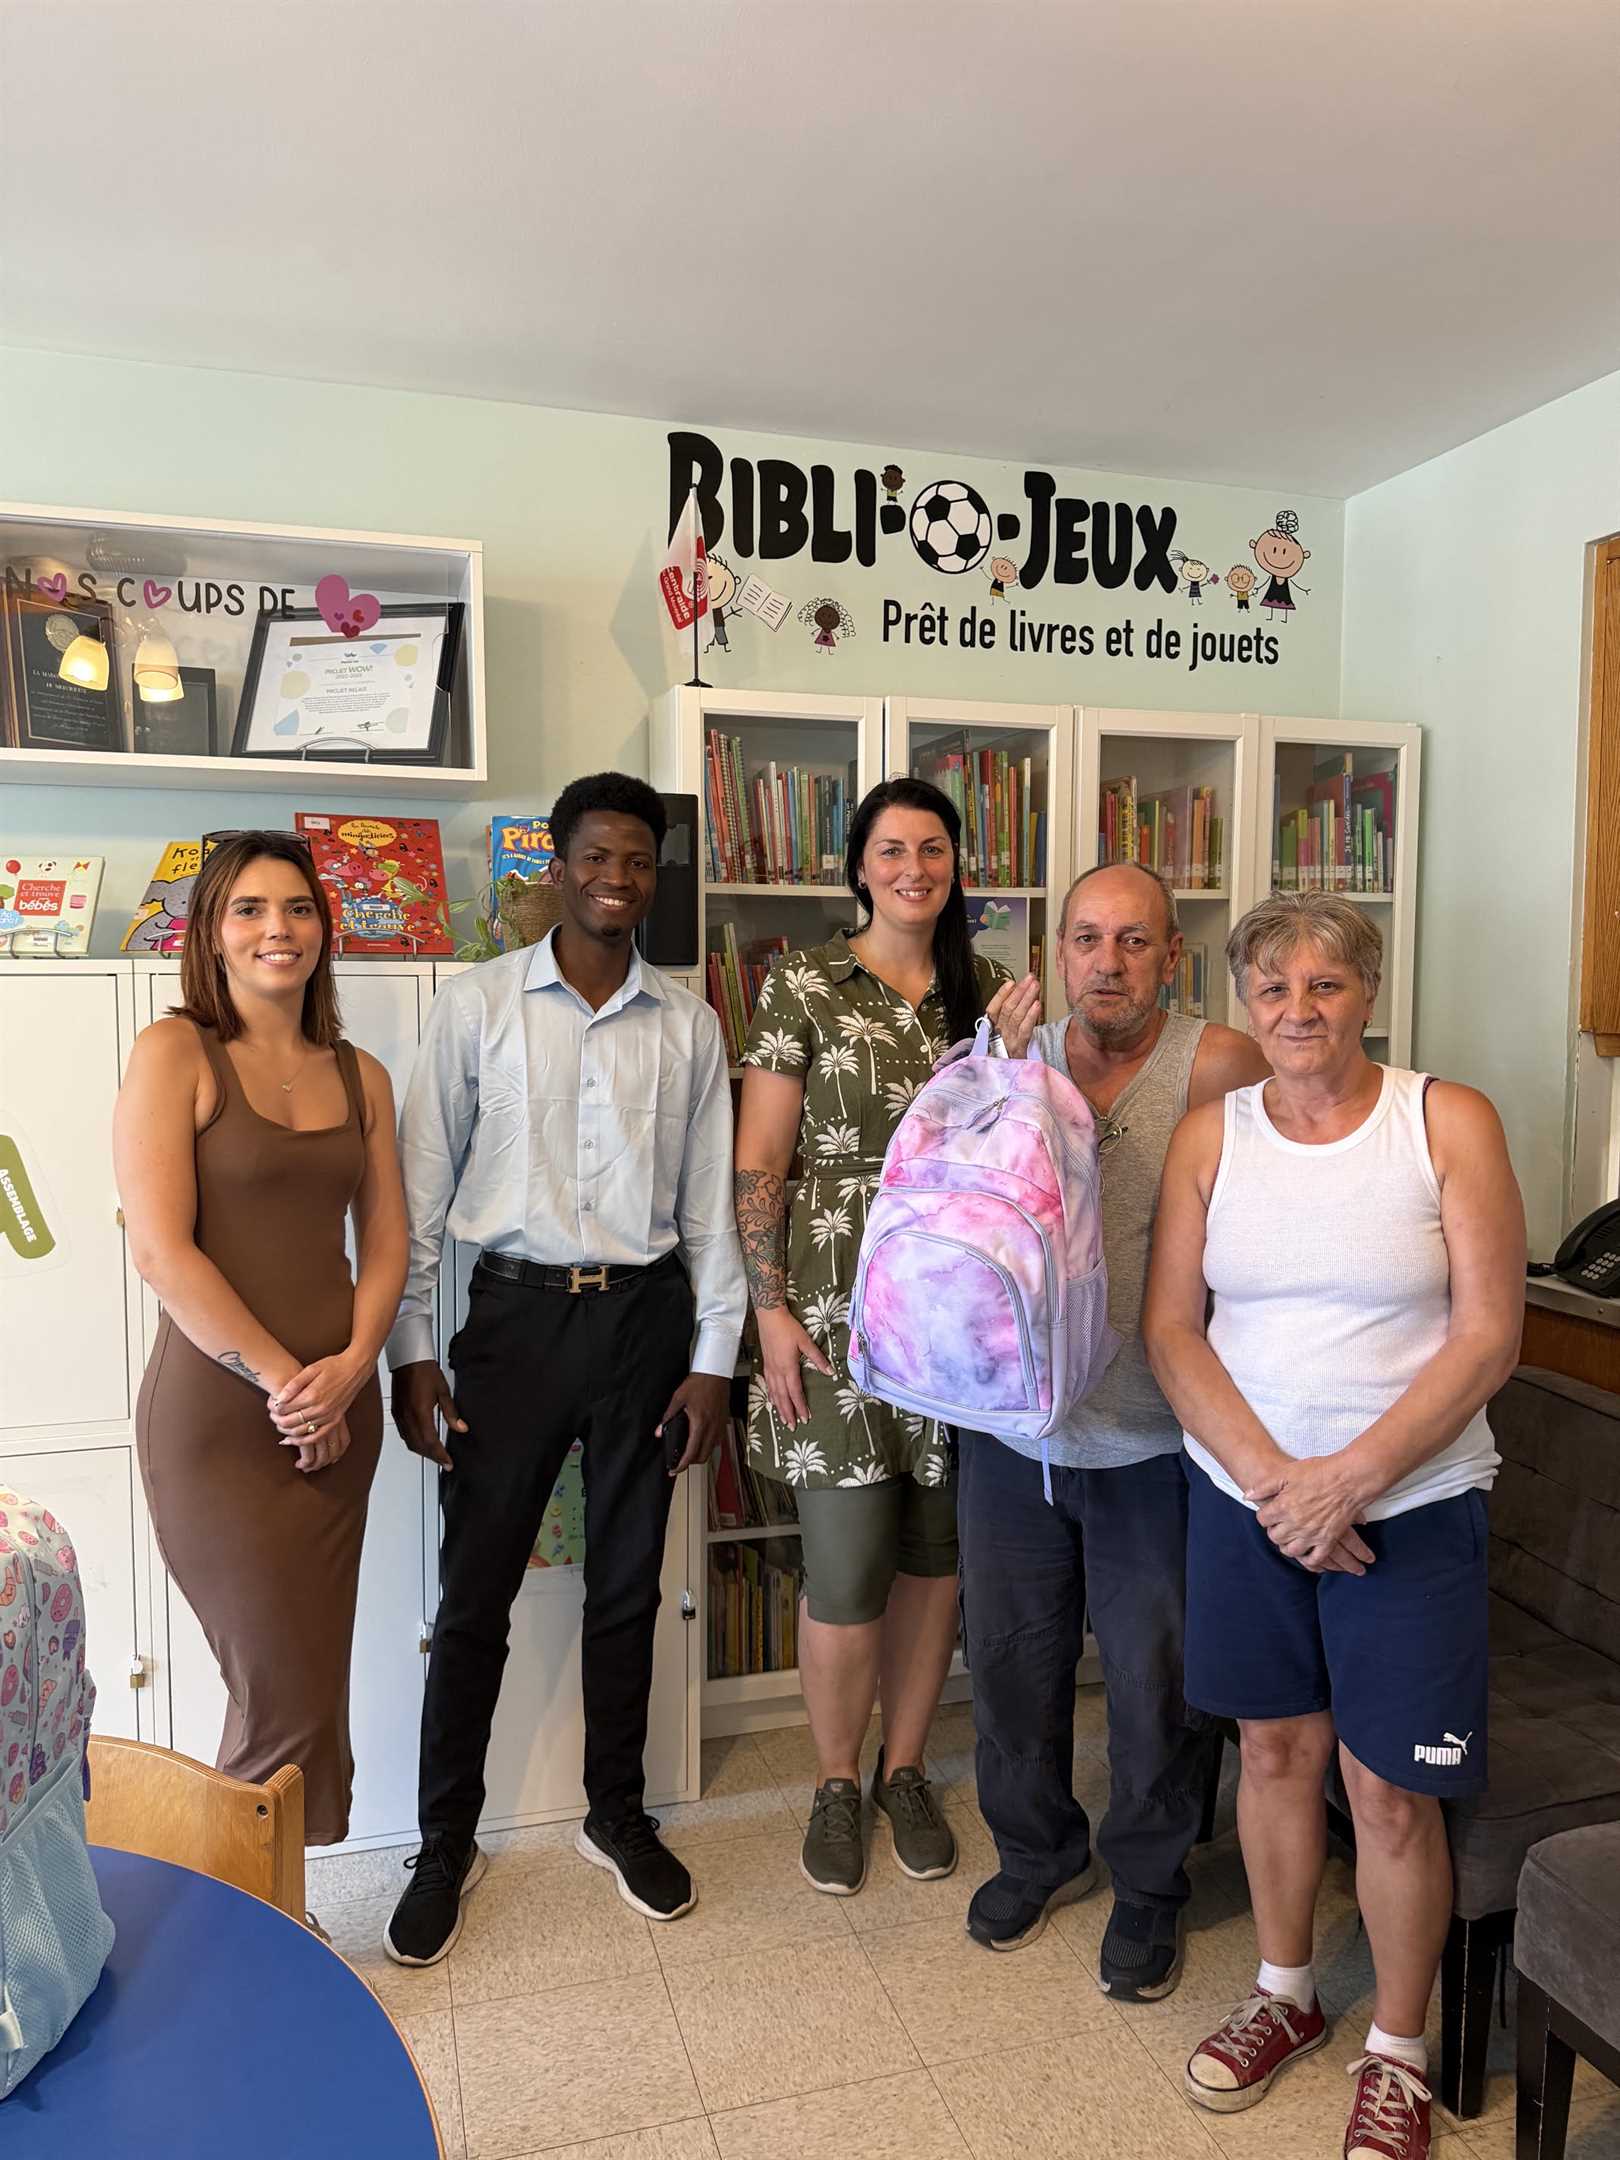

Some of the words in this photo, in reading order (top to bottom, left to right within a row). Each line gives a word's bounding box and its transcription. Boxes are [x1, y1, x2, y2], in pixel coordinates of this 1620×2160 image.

[259, 585, 296, 619] DE
[883, 600, 949, 647] Prêt
[960, 606, 996, 650] de
[1010, 609, 1095, 657] livres
[1106, 619, 1135, 659] et
[1145, 618, 1181, 660] de
[1187, 622, 1279, 672] jouets
[1414, 1744, 1462, 1766] PUMA
